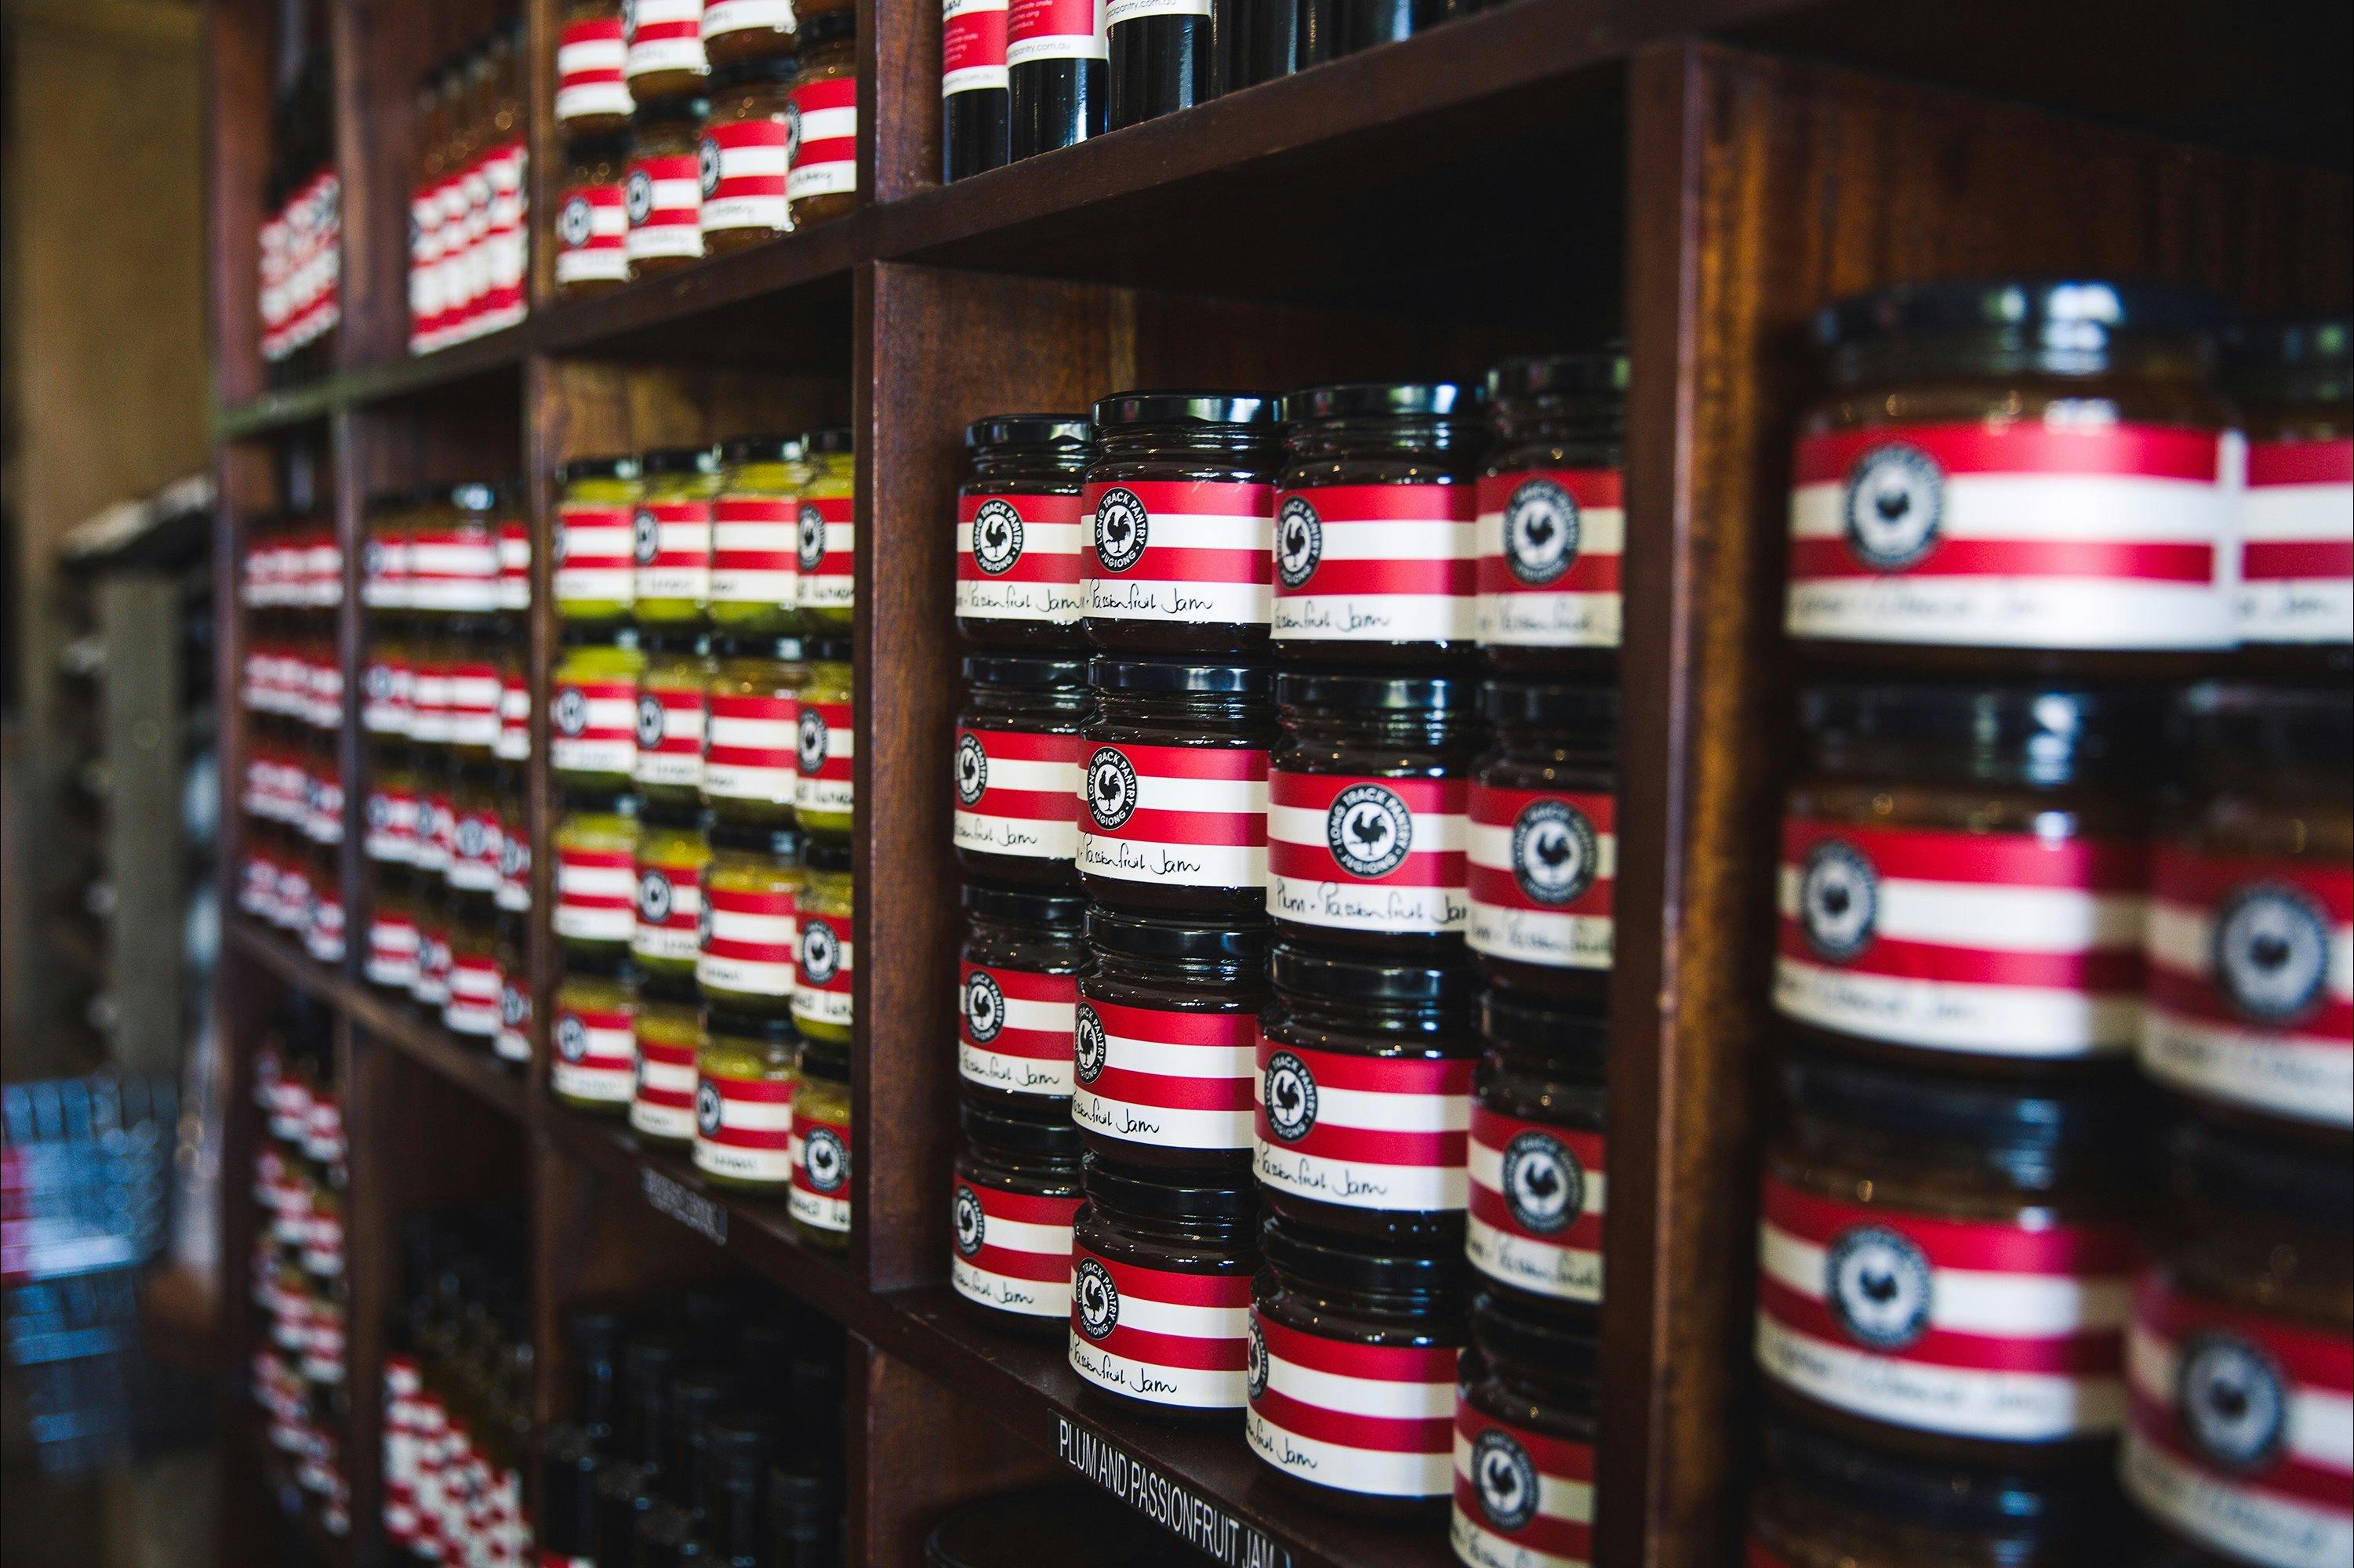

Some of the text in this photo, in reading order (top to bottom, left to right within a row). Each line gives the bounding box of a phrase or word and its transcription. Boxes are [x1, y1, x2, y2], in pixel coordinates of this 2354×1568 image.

[1096, 492, 1146, 544] LONG TRACK PANTRY
[1101, 550, 1136, 568] JUGIONG
[1036, 589, 1080, 612] Jam
[1161, 587, 1213, 614] Jam
[1335, 602, 1391, 633] Jam
[1094, 750, 1120, 766] TRACK
[1118, 760, 1135, 806] PANTRY
[1093, 808, 1127, 826] JUGIONG
[997, 824, 1038, 848] Jam
[1150, 849, 1201, 875] Jam
[1092, 1018, 1105, 1063] PANTRY
[1016, 1064, 1060, 1087] Jam
[1116, 1108, 1160, 1134] Jam
[1332, 1168, 1387, 1197] Jam
[994, 1280, 1034, 1304] Jam
[1082, 1262, 1103, 1278] TRACK
[1103, 1276, 1117, 1322] PANTRY
[1081, 1314, 1109, 1336] JUGIONG
[1130, 1367, 1178, 1393] Jam
[1277, 1437, 1317, 1469] Jam
[1059, 1418, 1097, 1481] PLUM
[1098, 1443, 1128, 1498] AND
[1131, 1461, 1240, 1566] PASSIONFRUIT
